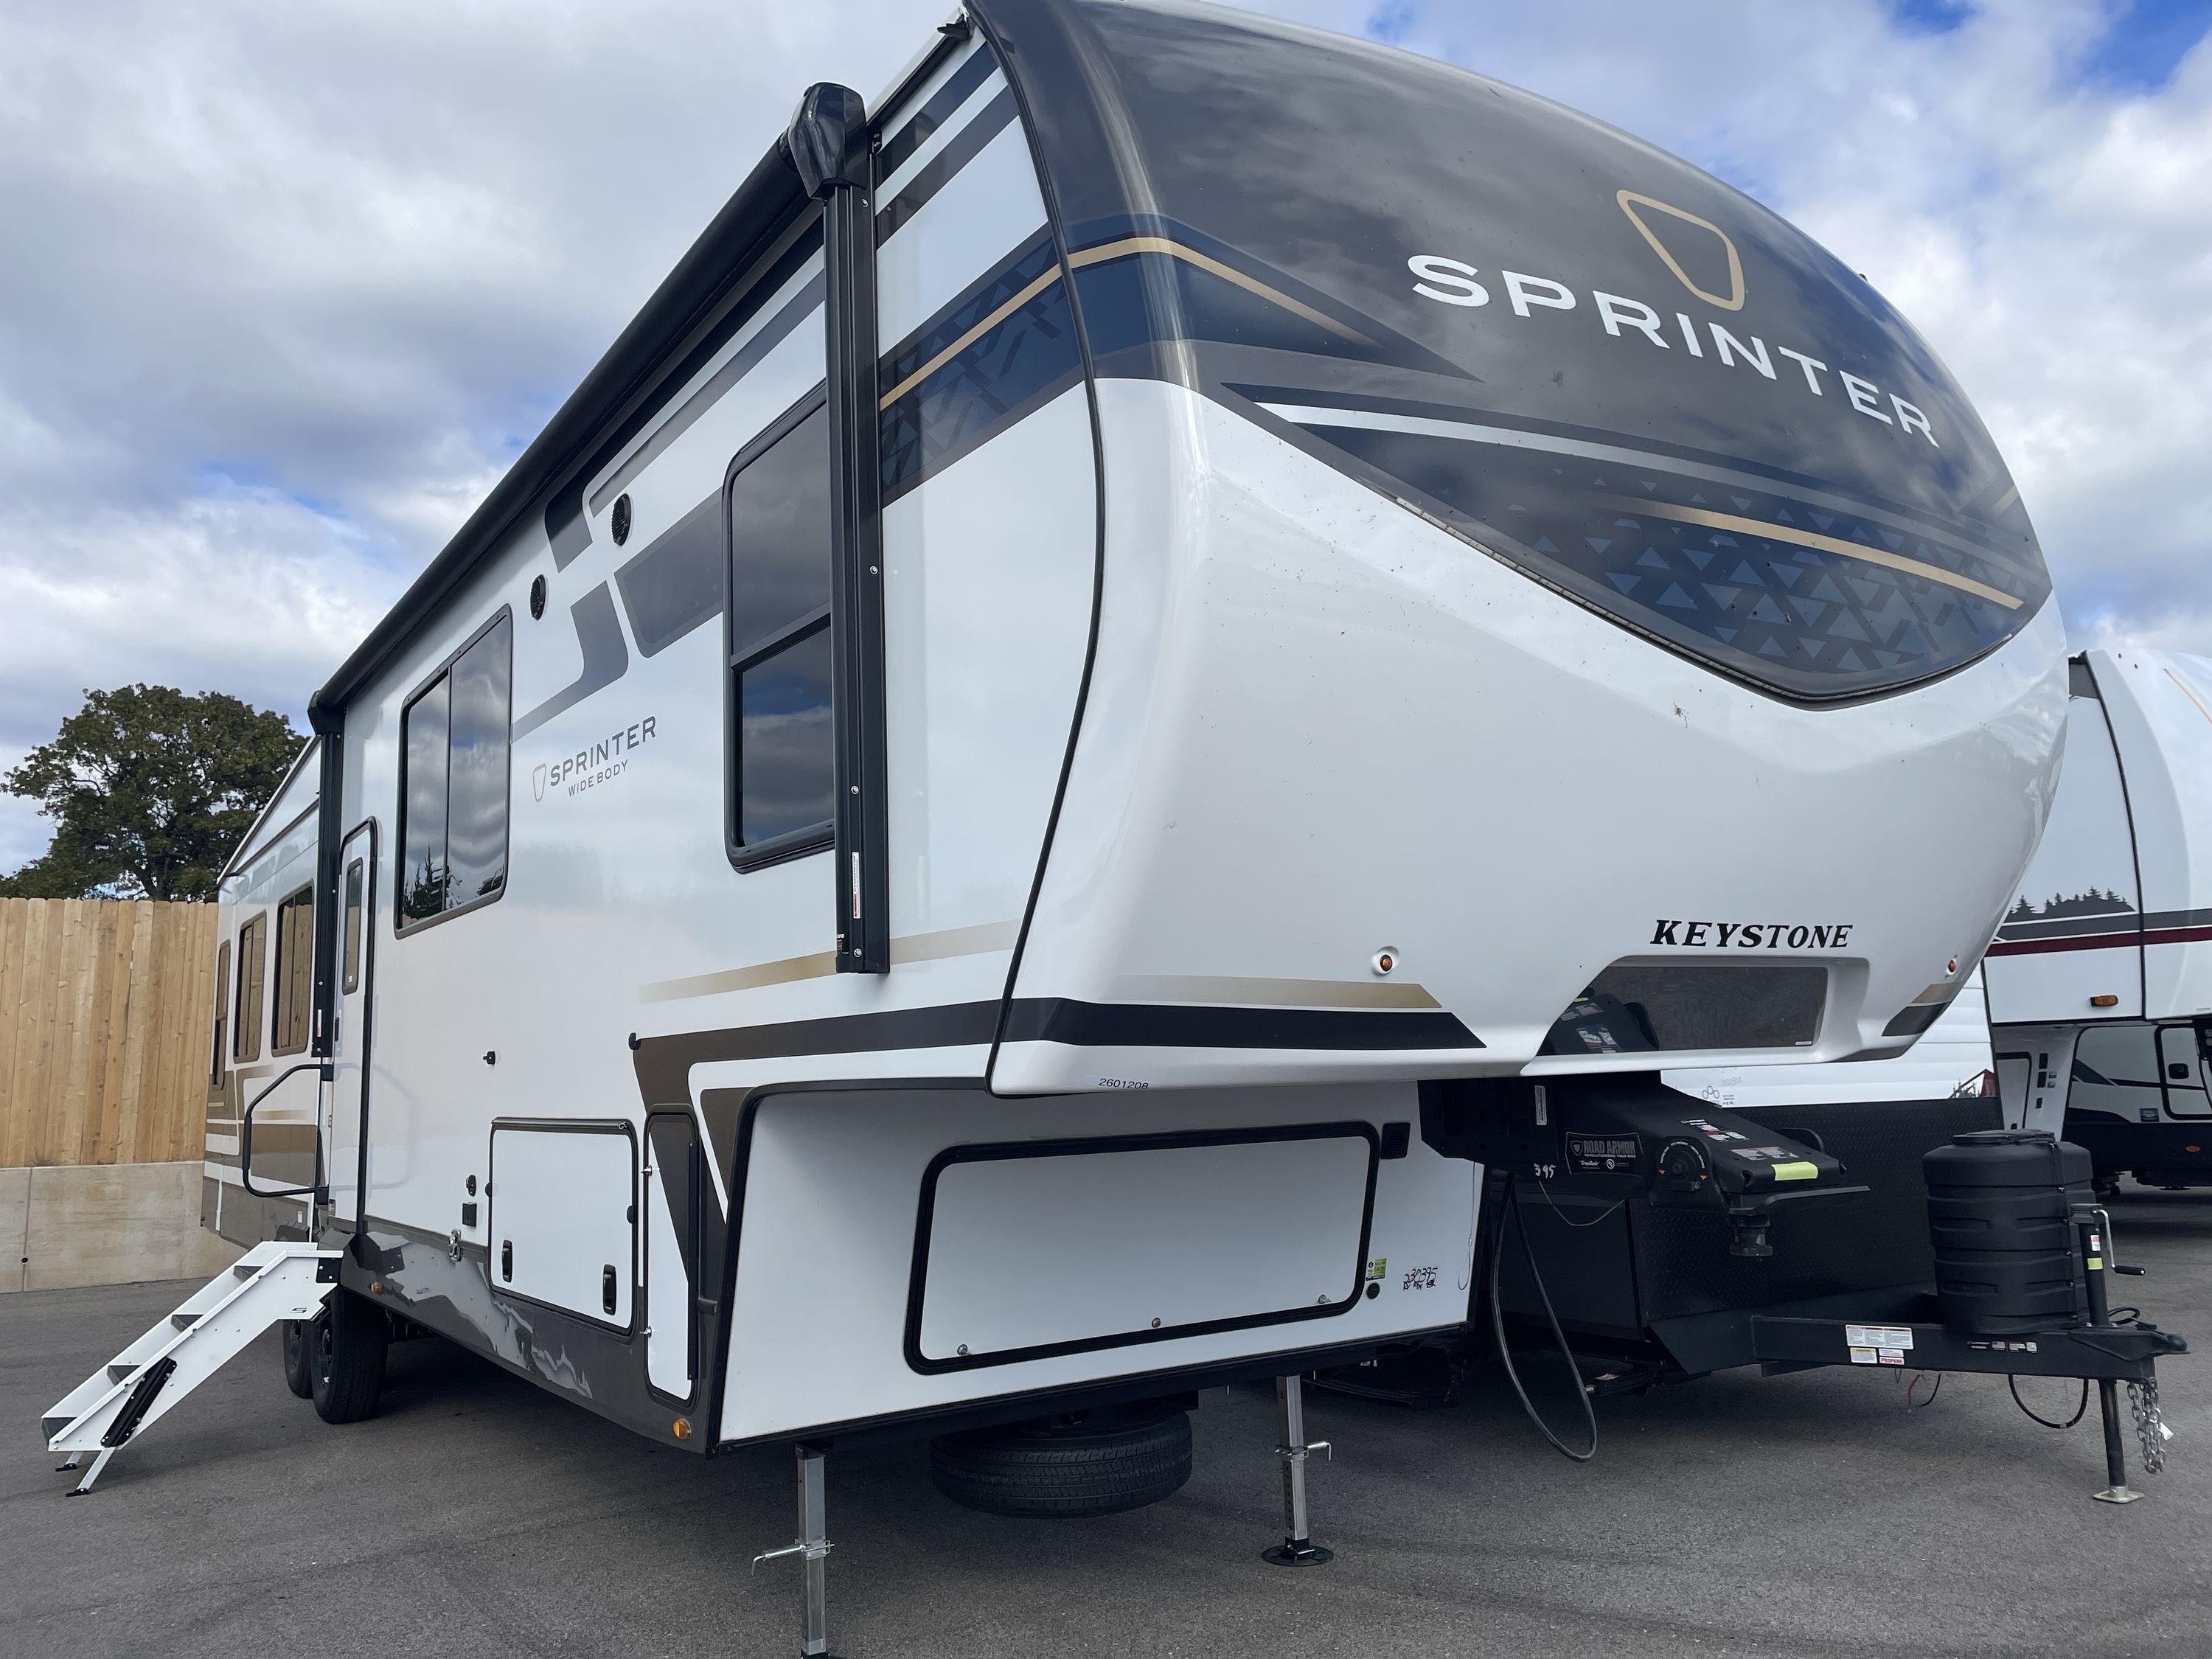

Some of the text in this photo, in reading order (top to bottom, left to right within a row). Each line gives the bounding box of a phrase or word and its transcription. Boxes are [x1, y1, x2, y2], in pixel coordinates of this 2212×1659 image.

[1407, 254, 1939, 448] SPRINTER
[550, 715, 656, 787] SPRINTER
[1650, 919, 1854, 948] KEYSTONE
[1099, 1078, 1149, 1089] 2601208
[1583, 1140, 1635, 1154] ROAD ARMOR
[1534, 1163, 1557, 1179] 395
